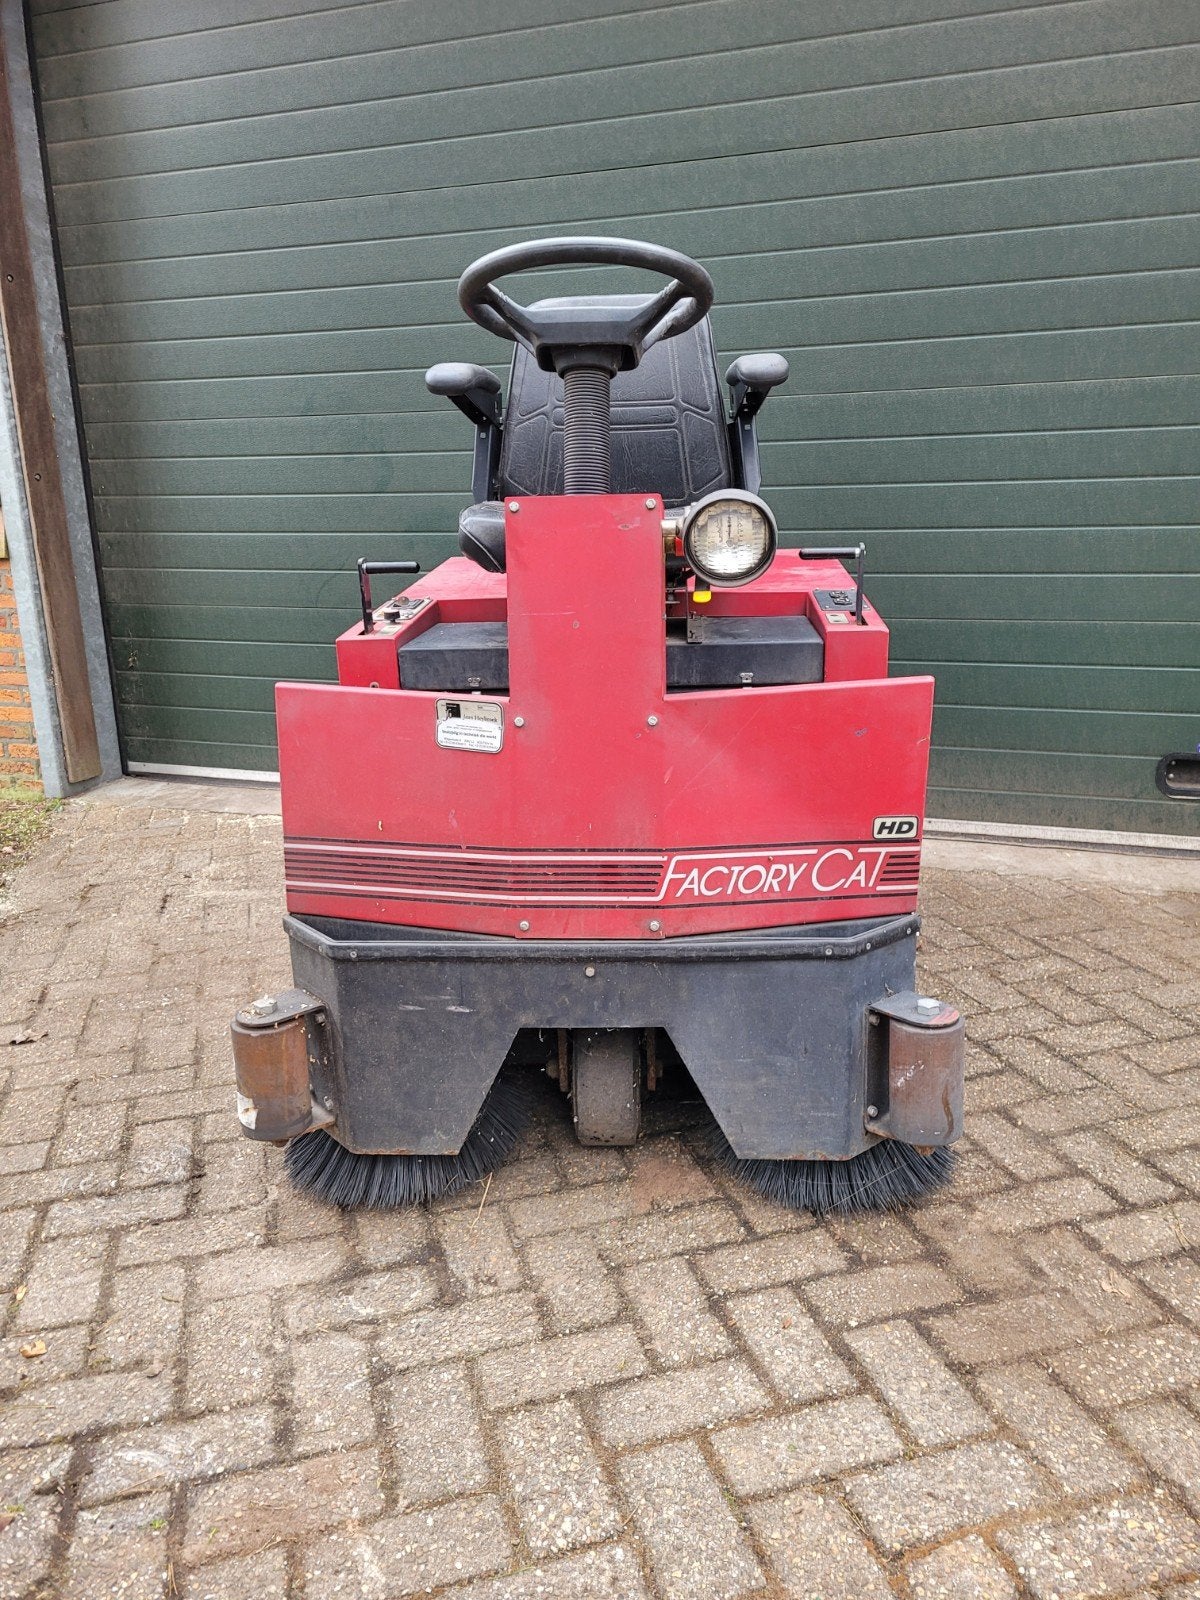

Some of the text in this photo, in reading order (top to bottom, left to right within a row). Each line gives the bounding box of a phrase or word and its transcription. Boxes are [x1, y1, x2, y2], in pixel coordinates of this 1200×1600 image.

[877, 821, 914, 835] HD
[660, 847, 896, 901] FACTORY CAT
